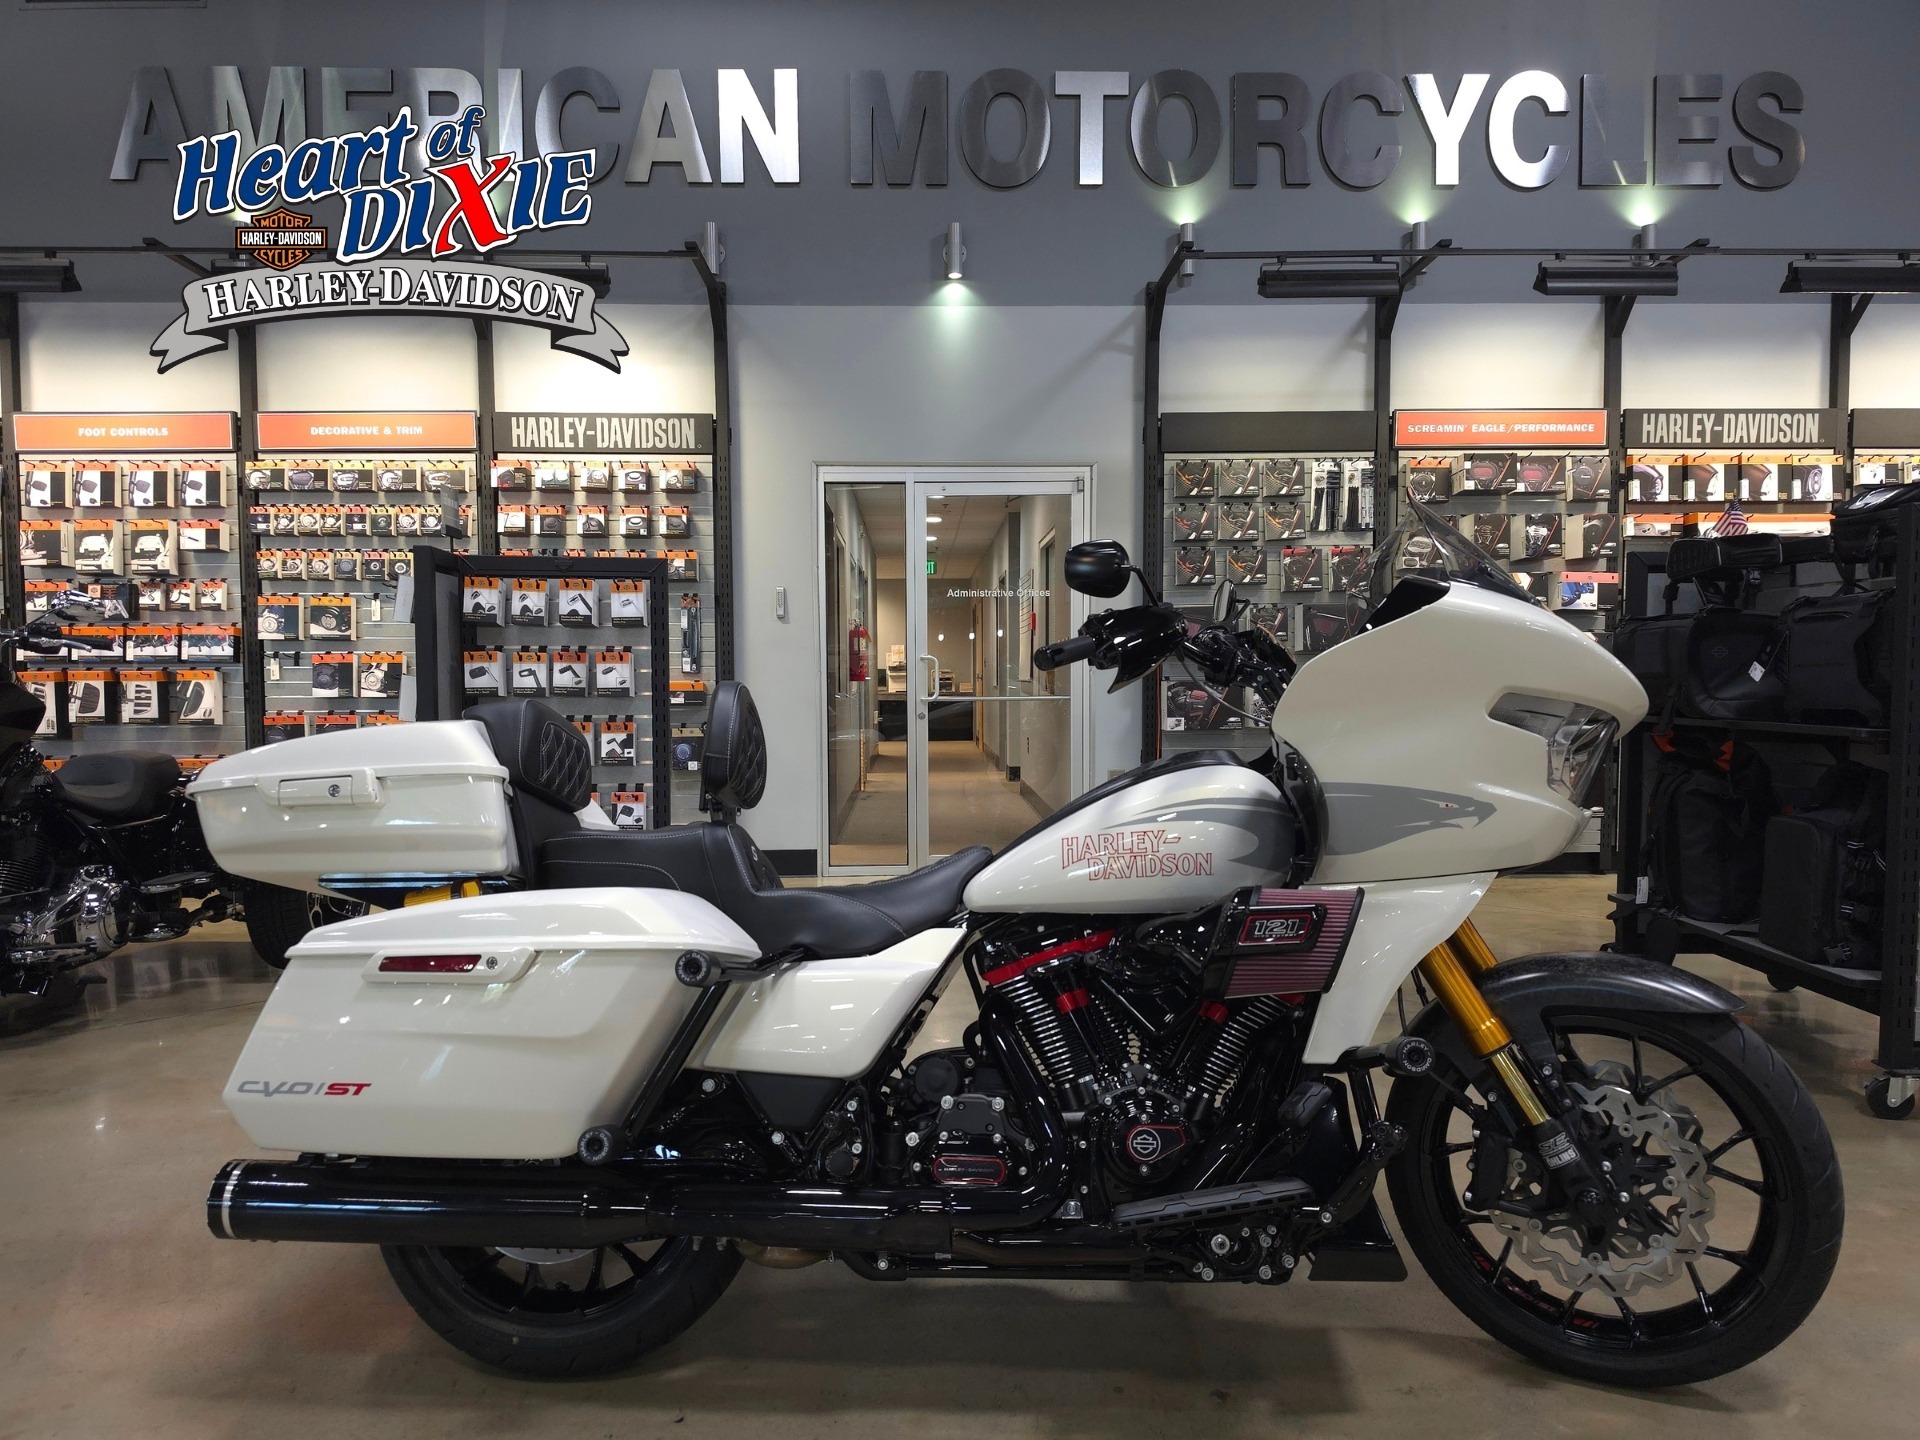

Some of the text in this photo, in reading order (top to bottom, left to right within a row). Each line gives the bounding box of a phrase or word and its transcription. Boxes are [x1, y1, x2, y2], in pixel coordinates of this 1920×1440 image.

[849, 69, 1806, 190] MOTORCYCLES
[78, 427, 169, 437] FOOT CONTROLS
[310, 425, 423, 435] DECORATIVE & TRIM
[511, 416, 696, 449] HARLEY-DAVIDSON
[1407, 424, 1468, 433] SCREAMIN'
[1642, 413, 1820, 444] HARLEY-DAVIDSON
[946, 588, 1051, 598] Administrative Offices
[1088, 852, 1213, 881] DAVIDSON
[1254, 919, 1299, 935] 121
